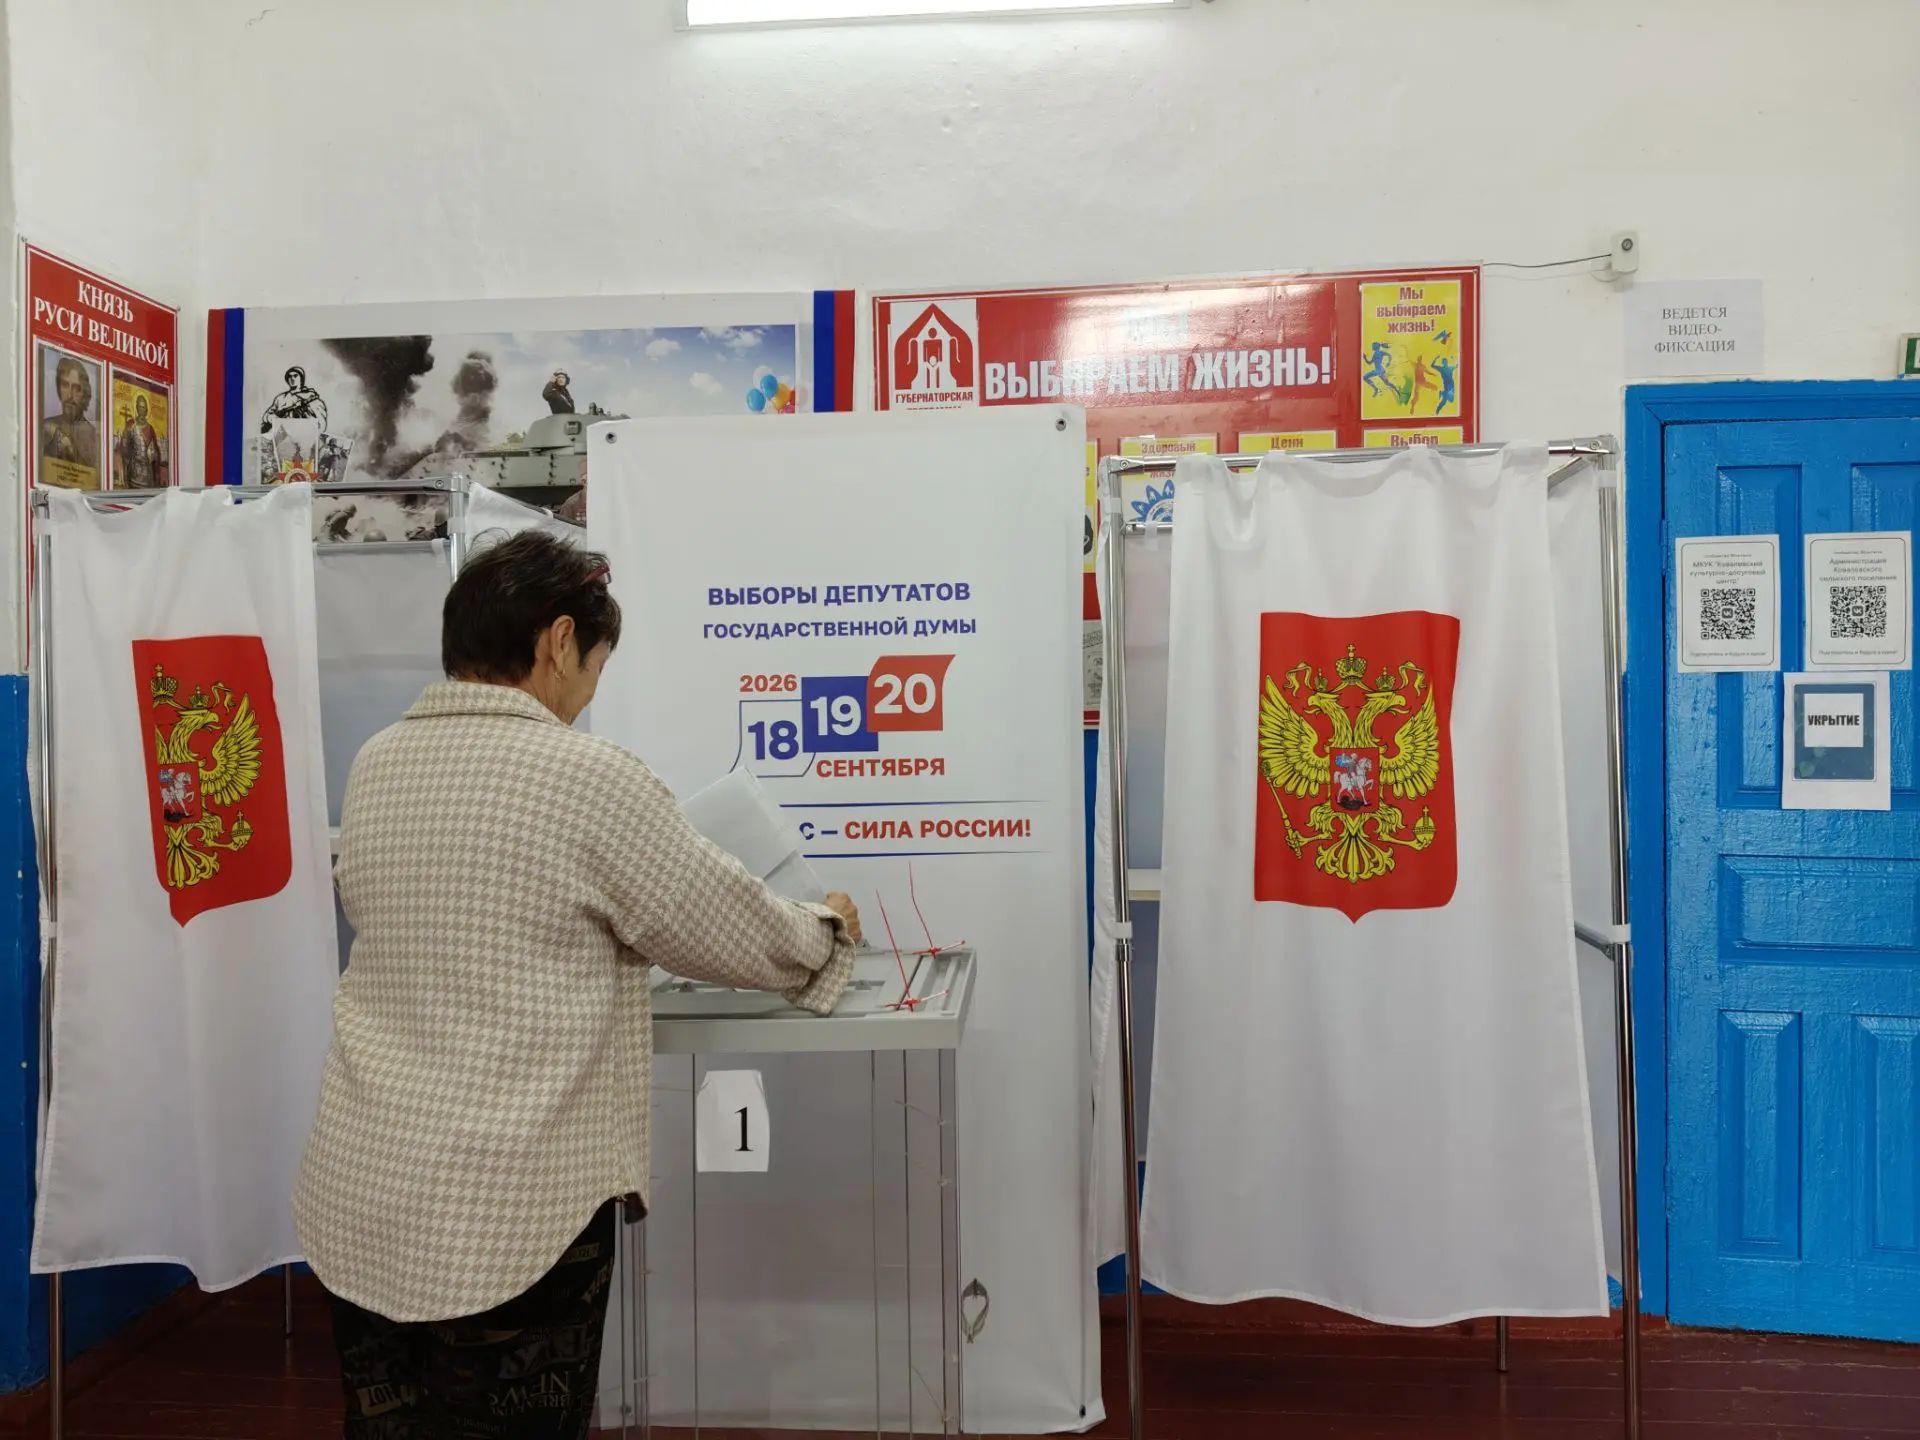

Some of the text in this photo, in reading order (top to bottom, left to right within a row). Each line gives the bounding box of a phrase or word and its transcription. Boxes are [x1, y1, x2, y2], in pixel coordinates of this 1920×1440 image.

[78, 280, 134, 323] КНЯЗЬ
[1400, 287, 1423, 300] Мы
[1376, 304, 1446, 318] выбираем
[1662, 307, 1727, 320] ВЕДЕТСЯ
[34, 297, 169, 369] РУСИ ВЕЛИКОЙ
[1387, 320, 1435, 333] жизнь!
[1668, 323, 1722, 336] ВИДЕО-
[1654, 340, 1735, 353] ФИКСАЦИЯ
[985, 346, 1331, 400] ВЫБИРАЕМ ЖИЗНЬ!
[895, 391, 973, 404] ГУБЕРНАТОРСКАЯ
[708, 582, 971, 606] ВЫБОРЫ ДЕПУТАТОВ
[703, 617, 977, 640] ГОСУДАРСТВЕННОЙ ДУМЫ
[739, 674, 798, 692] 2026
[873, 673, 936, 714] 20
[810, 695, 862, 736] 19
[1807, 715, 1860, 726] УКРЫТИЕ
[747, 720, 800, 760] 18
[816, 757, 945, 778] СЕНТЯБРЯ
[844, 820, 914, 840] СИЛА
[920, 819, 1032, 838] РОССИИ!
[734, 1106, 754, 1152] 1
